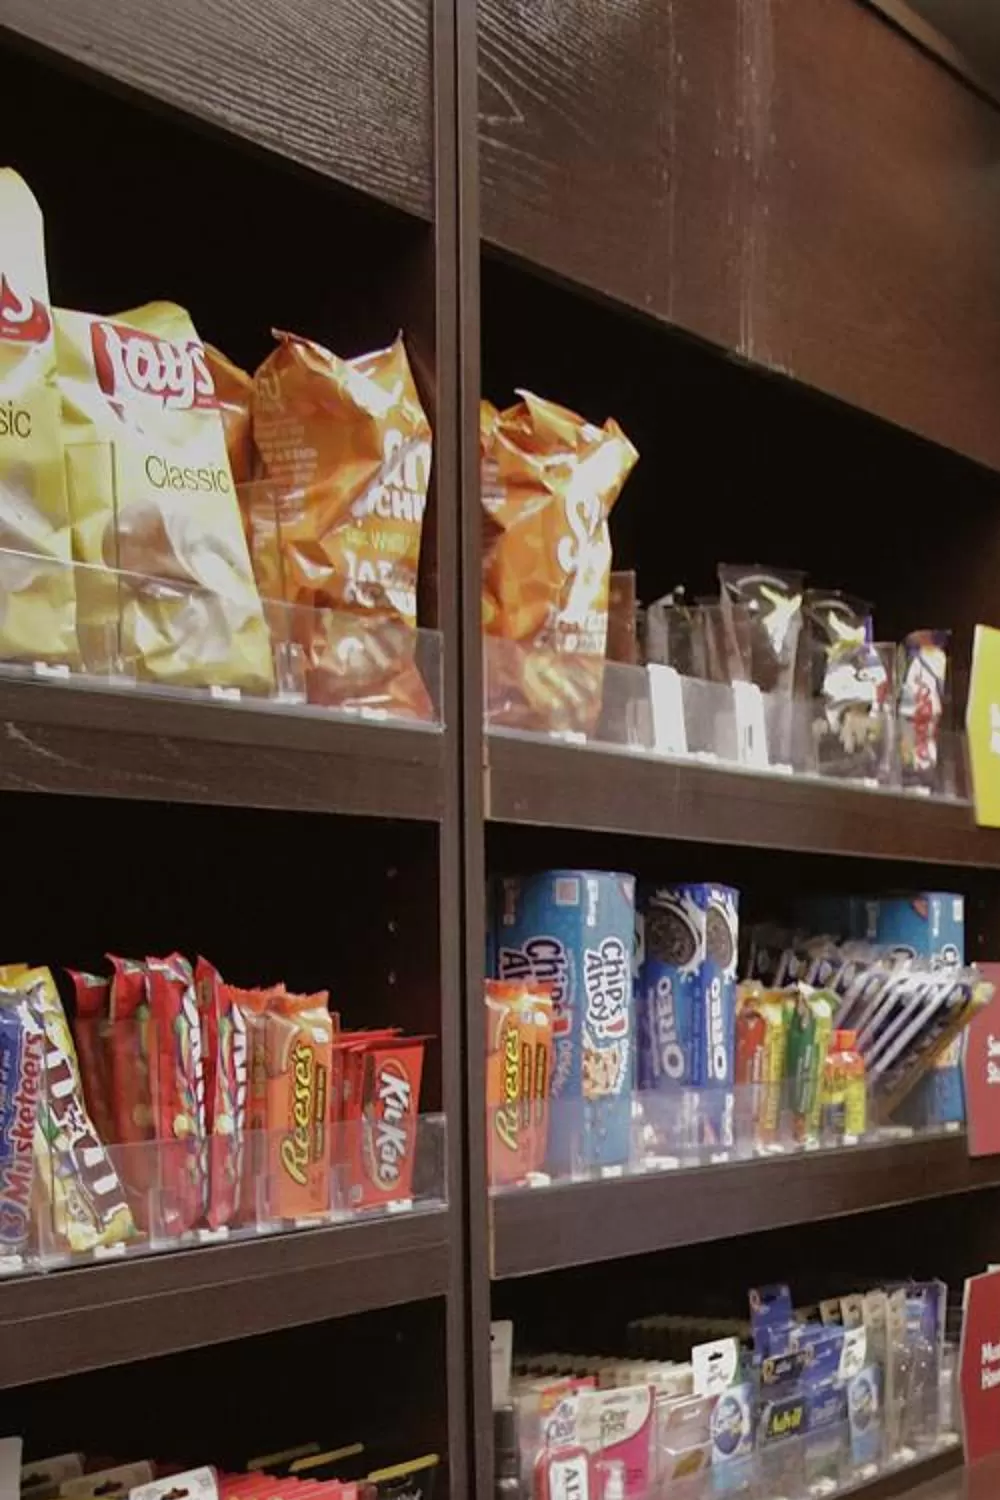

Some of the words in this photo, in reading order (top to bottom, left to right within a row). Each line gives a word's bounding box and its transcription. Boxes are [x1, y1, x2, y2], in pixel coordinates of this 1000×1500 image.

[145, 455, 230, 494] Classic
[5, 1031, 43, 1207] Musketeers
[281, 1041, 314, 1185] Reese's
[495, 1028, 519, 1151] Reese's
